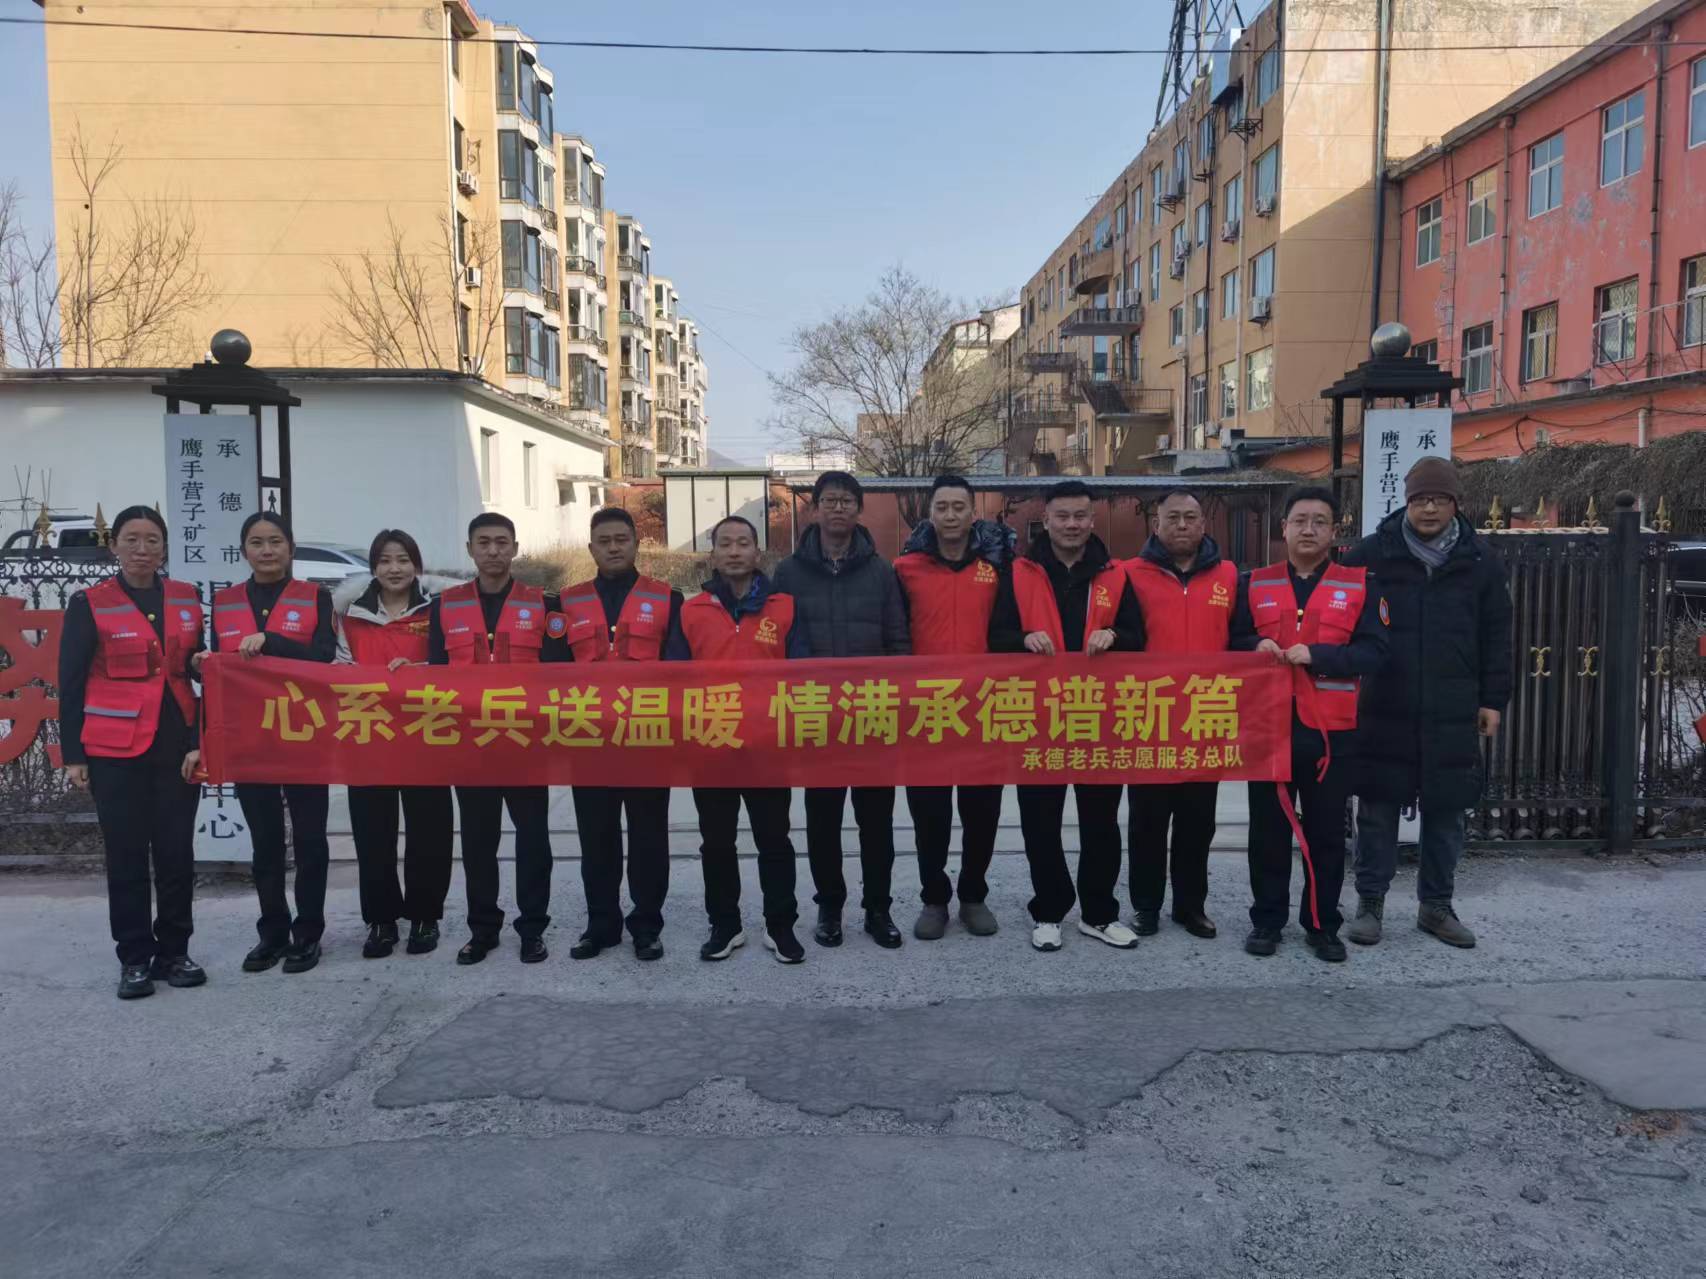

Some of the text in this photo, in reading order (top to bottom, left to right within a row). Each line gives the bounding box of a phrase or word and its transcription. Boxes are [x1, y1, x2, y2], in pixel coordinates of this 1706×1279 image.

[180, 437, 207, 564] 鹰手营子矿区
[217, 438, 243, 564] 承德市
[1379, 430, 1400, 515] 鹰手营子
[261, 674, 1244, 749] 心系老兵送温暖 情满承德谱新篇
[1020, 744, 1244, 772] 承德老兵志愿服务总队
